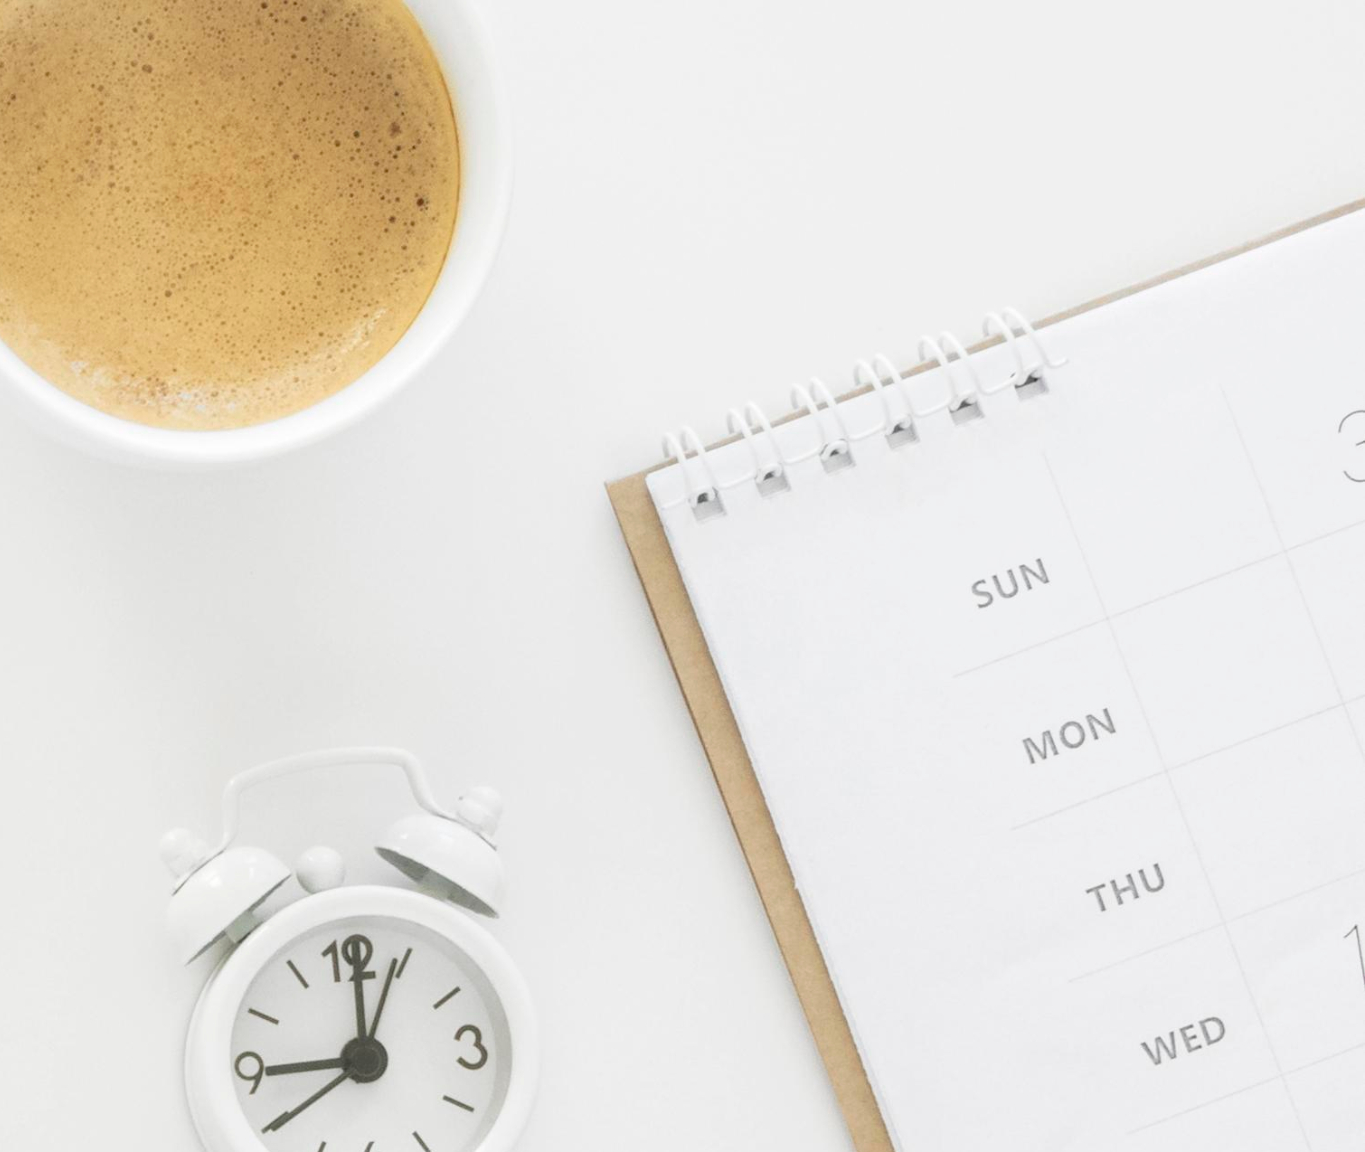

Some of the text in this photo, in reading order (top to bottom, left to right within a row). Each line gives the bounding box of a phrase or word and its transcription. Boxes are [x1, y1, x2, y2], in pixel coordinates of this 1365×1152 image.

[971, 557, 1050, 609] SUN
[1022, 707, 1117, 765] MON
[1085, 862, 1165, 912] THU
[321, 934, 376, 982] 12
[453, 1023, 489, 1071] 3
[1140, 1016, 1226, 1066] WED
[233, 1050, 265, 1095] 9
